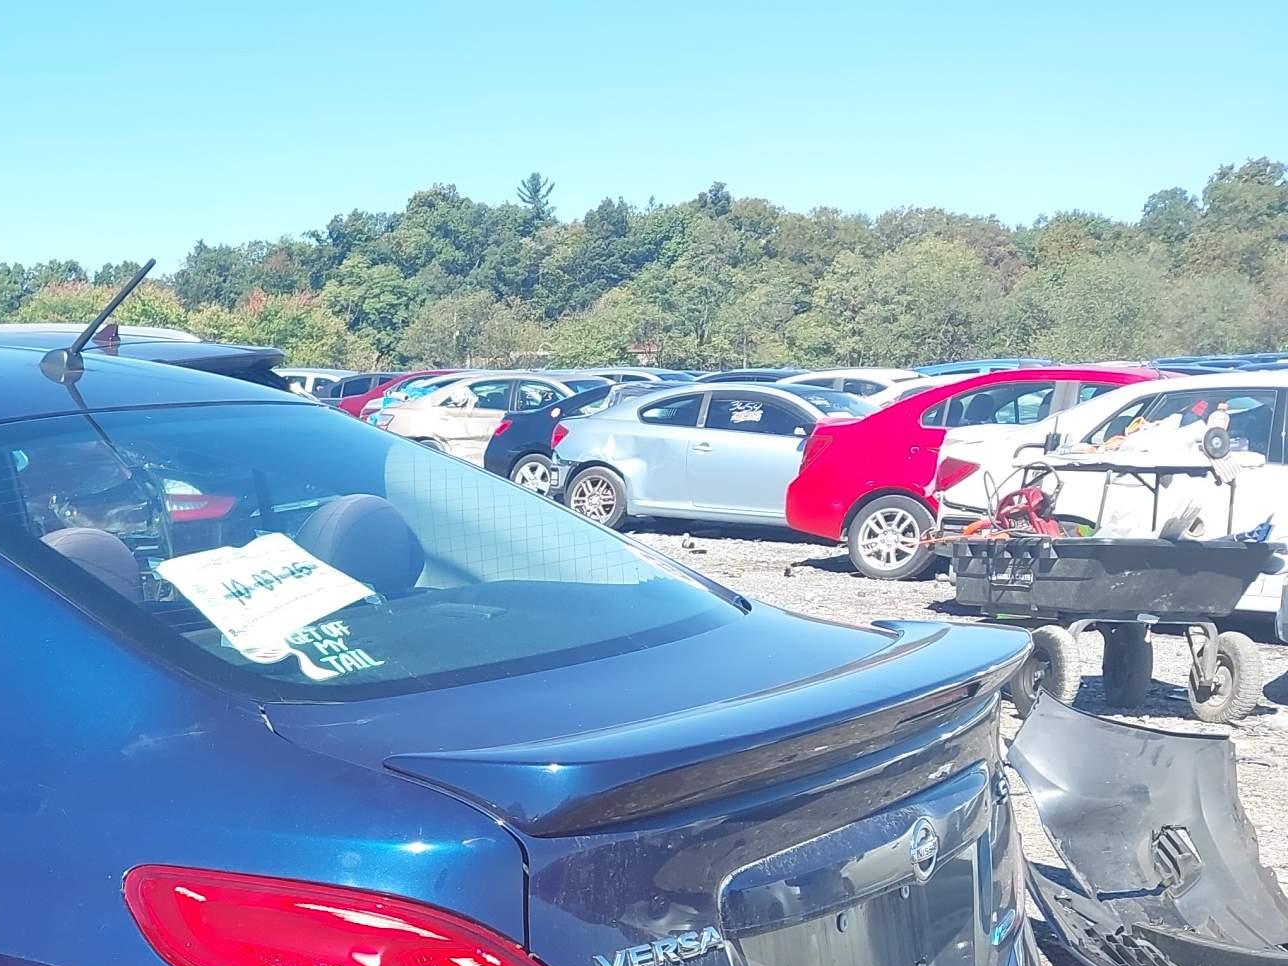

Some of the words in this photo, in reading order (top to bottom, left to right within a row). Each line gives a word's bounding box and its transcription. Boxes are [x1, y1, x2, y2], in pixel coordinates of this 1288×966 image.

[285, 627, 323, 645] GET
[320, 620, 351, 638] OFF
[312, 637, 349, 655] MY
[319, 648, 385, 674] TAIL
